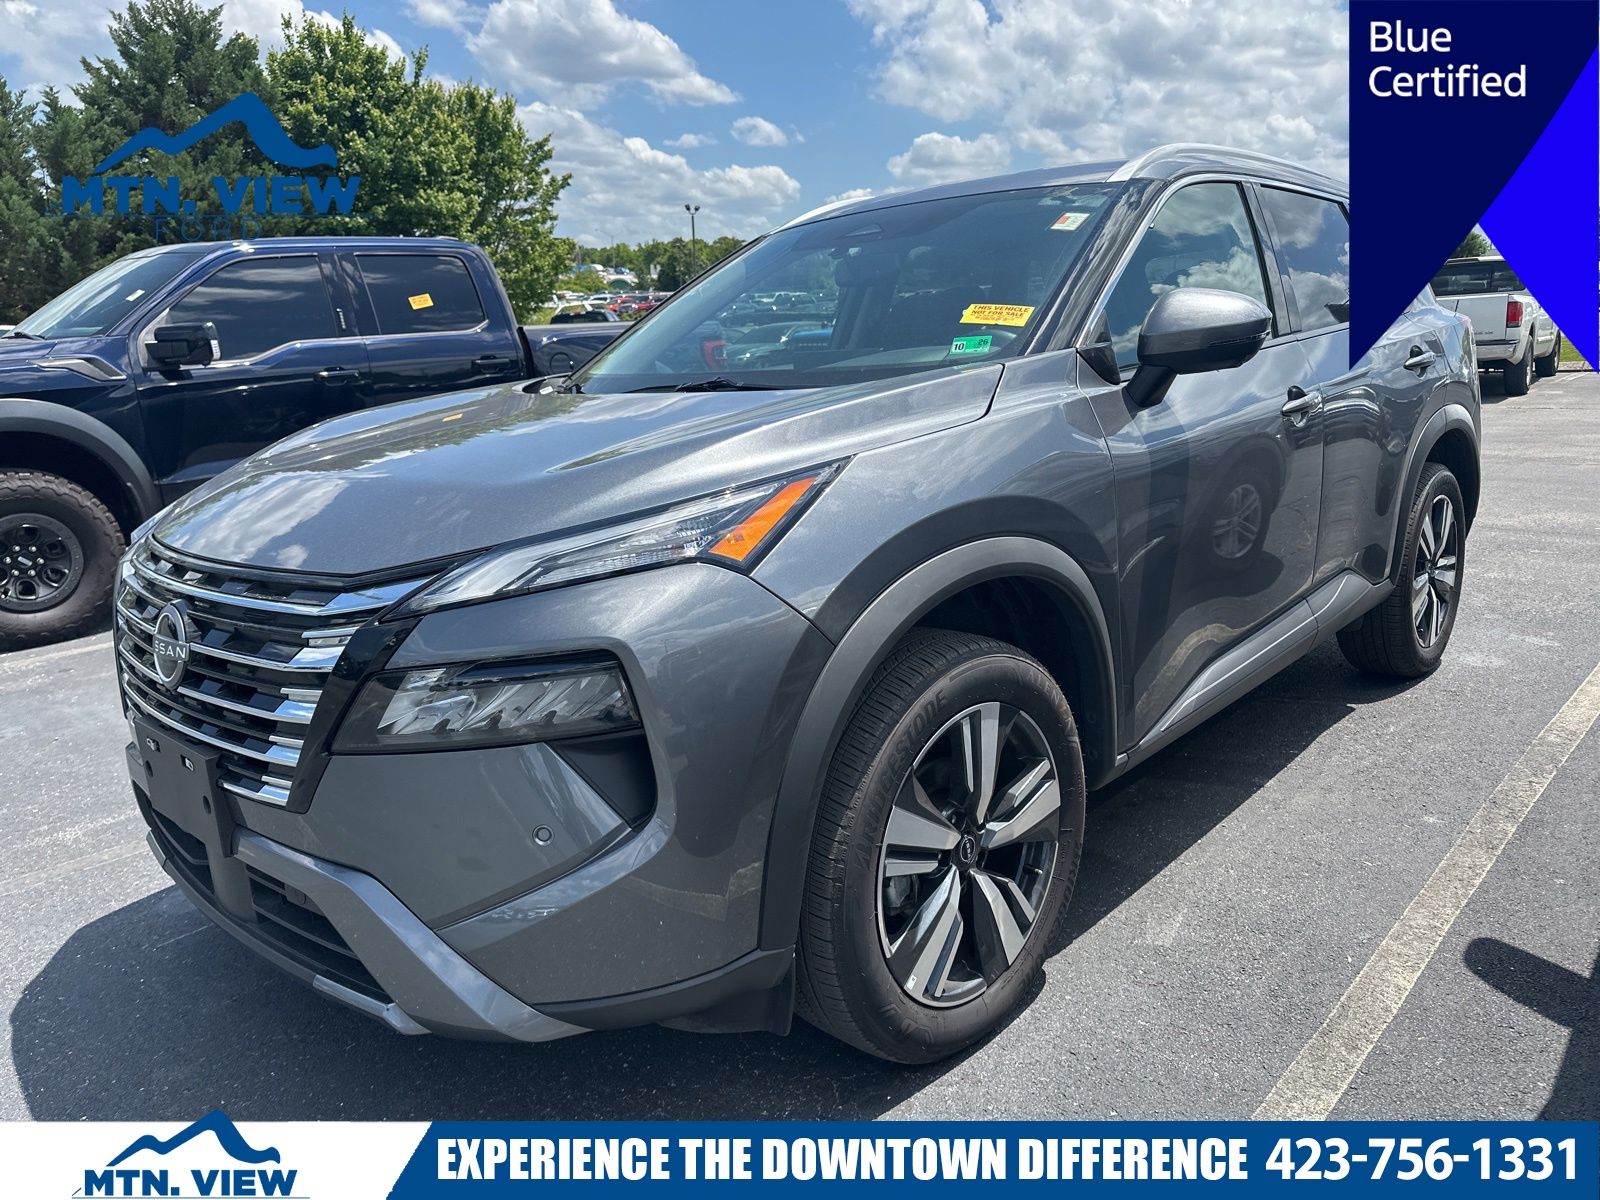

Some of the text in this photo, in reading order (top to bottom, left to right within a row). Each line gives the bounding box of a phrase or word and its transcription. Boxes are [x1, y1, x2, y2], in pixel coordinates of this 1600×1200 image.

[994, 305, 1031, 313] VEHICLE
[954, 343, 965, 351] 10
[154, 639, 186, 659] SSAN
